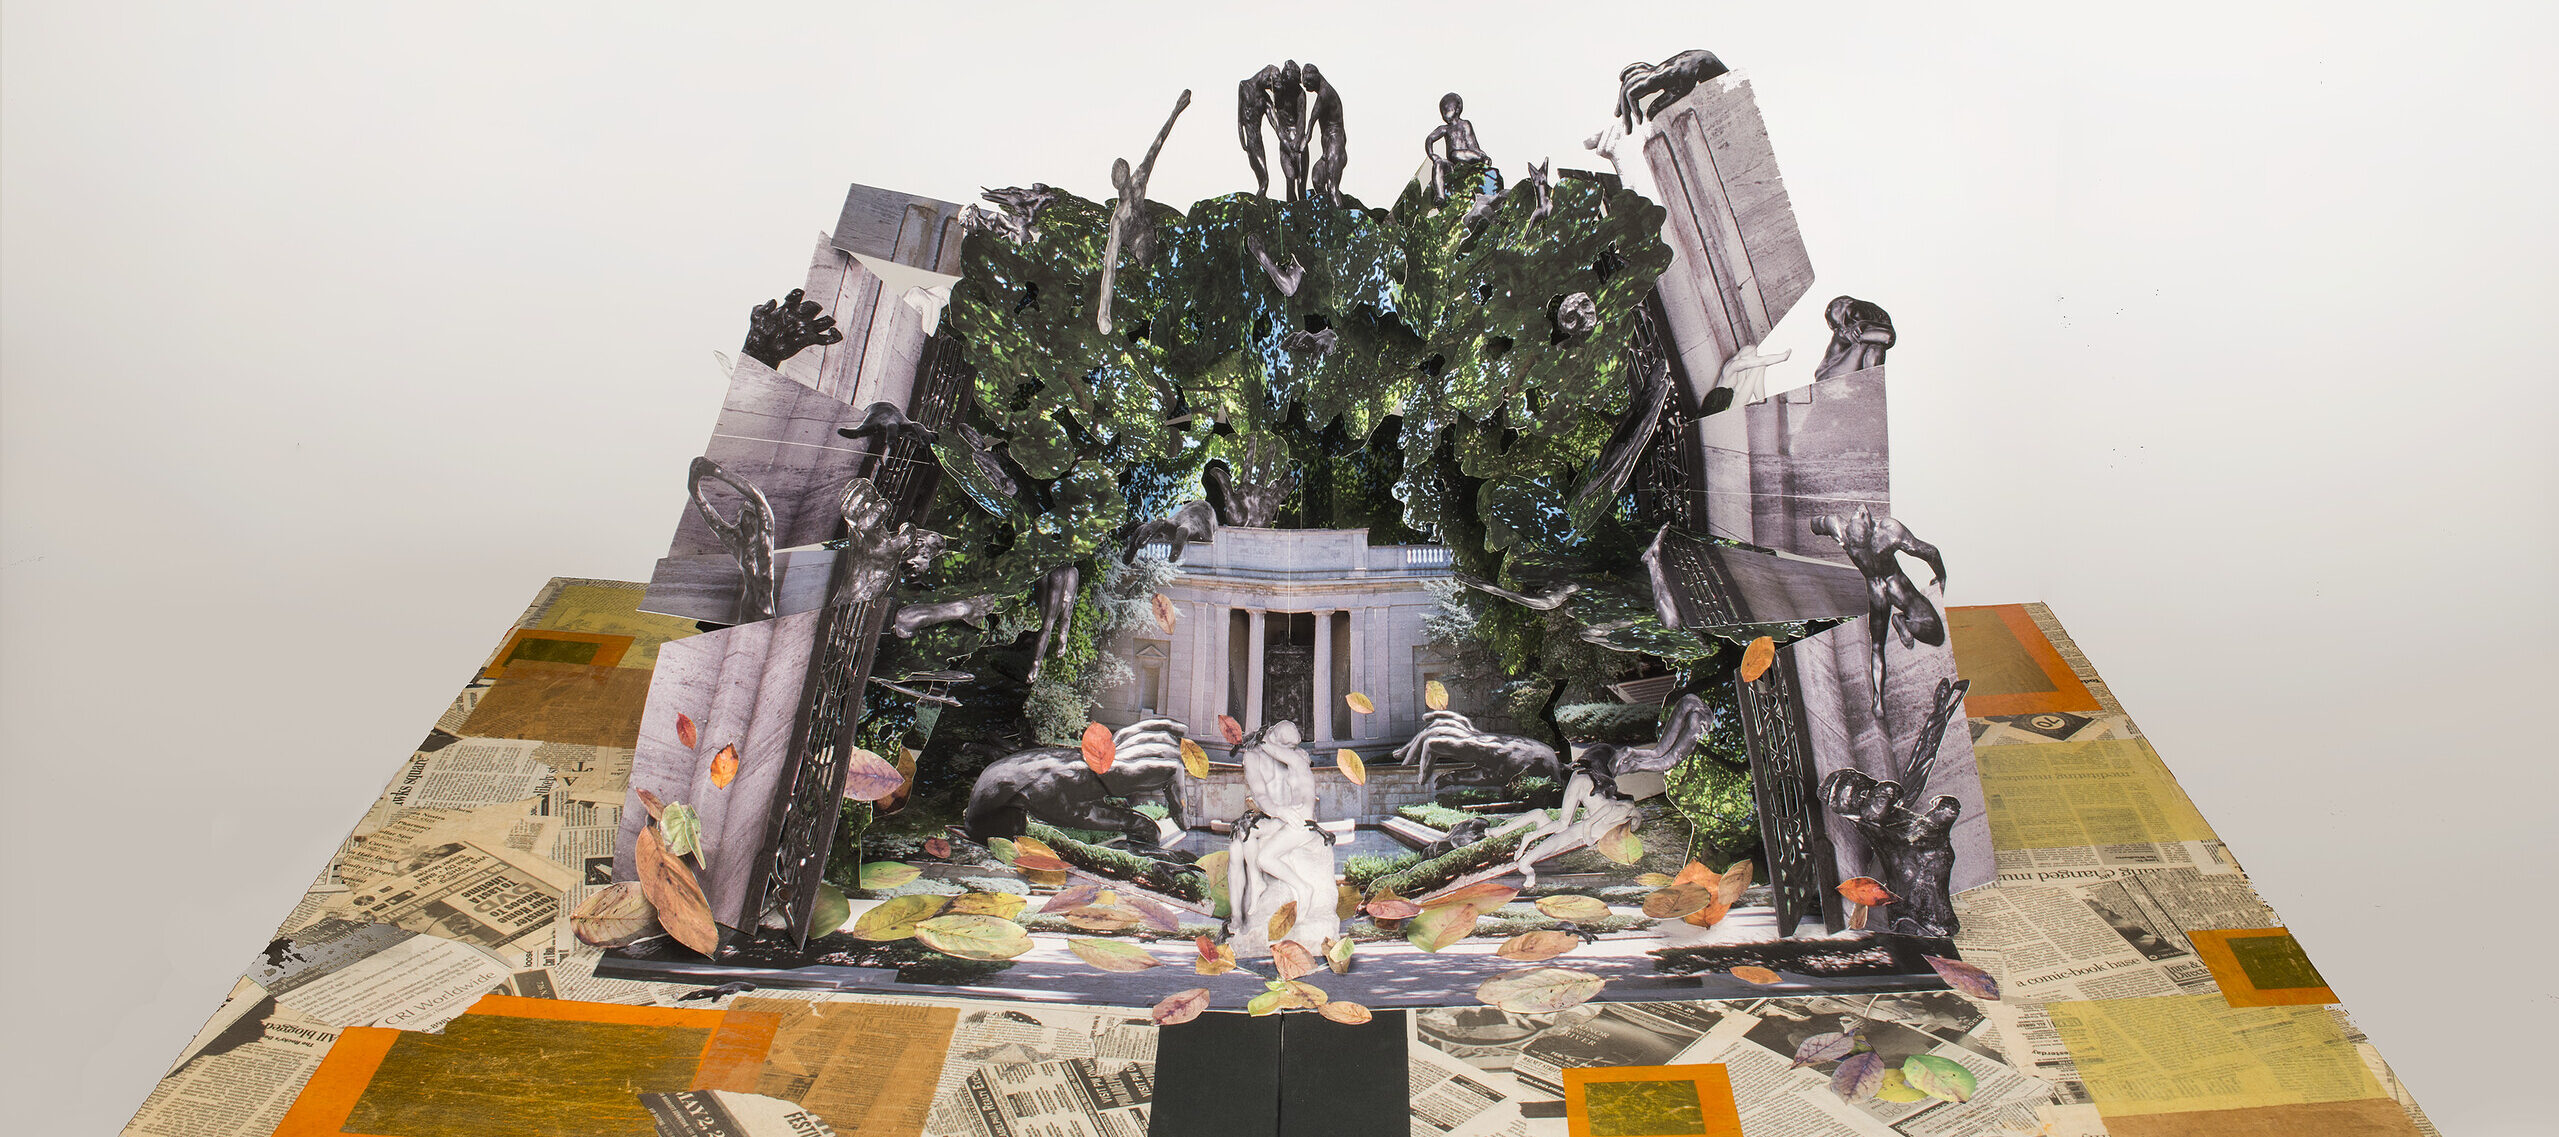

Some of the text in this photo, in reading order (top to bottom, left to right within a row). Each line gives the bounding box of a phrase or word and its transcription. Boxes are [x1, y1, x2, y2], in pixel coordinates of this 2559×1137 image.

[461, 876, 508, 897] Lifetime
[473, 882, 538, 912] DVD
[478, 886, 504, 899] Last
[501, 880, 519, 889] To
[490, 891, 545, 917] Videos To
[497, 895, 557, 923] Your Home
[2015, 958, 2142, 988] a comic-book base
[384, 1009, 415, 1025] CRI
[414, 971, 497, 1011] Worldwide
[316, 1032, 337, 1043] All
